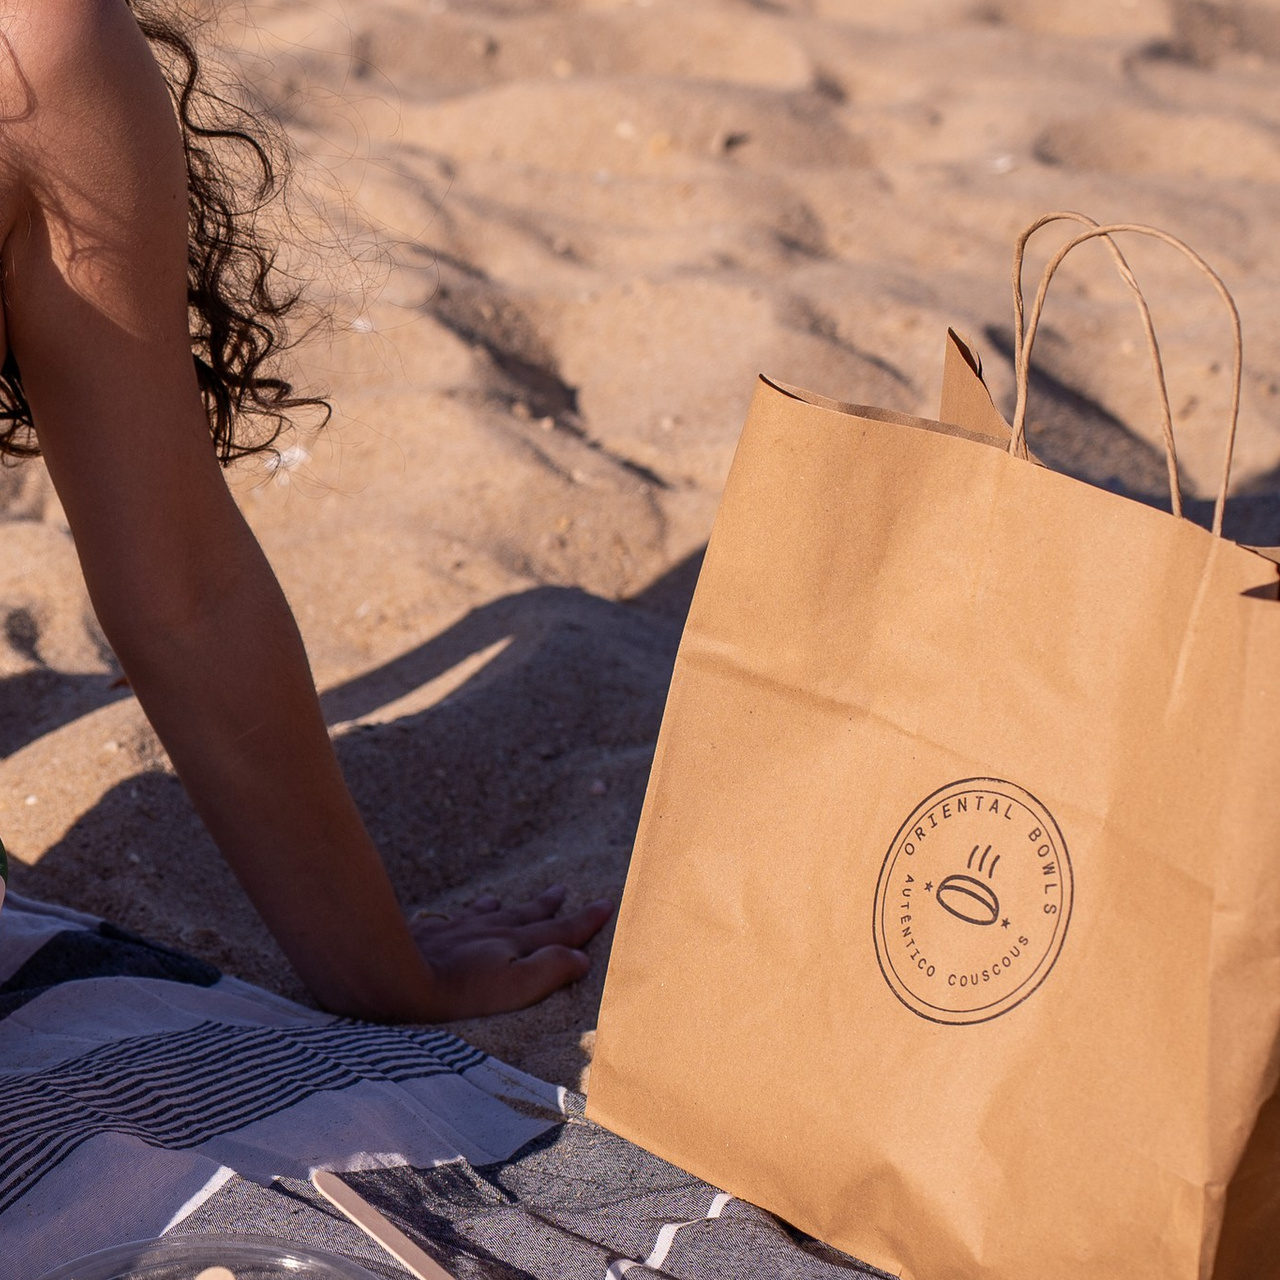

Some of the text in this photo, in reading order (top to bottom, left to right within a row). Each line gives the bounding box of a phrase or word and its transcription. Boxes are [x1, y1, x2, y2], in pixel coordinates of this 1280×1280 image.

[904, 795, 1058, 915] ORIENTAL BOWLS
[947, 934, 1030, 987] COUSCOUS
